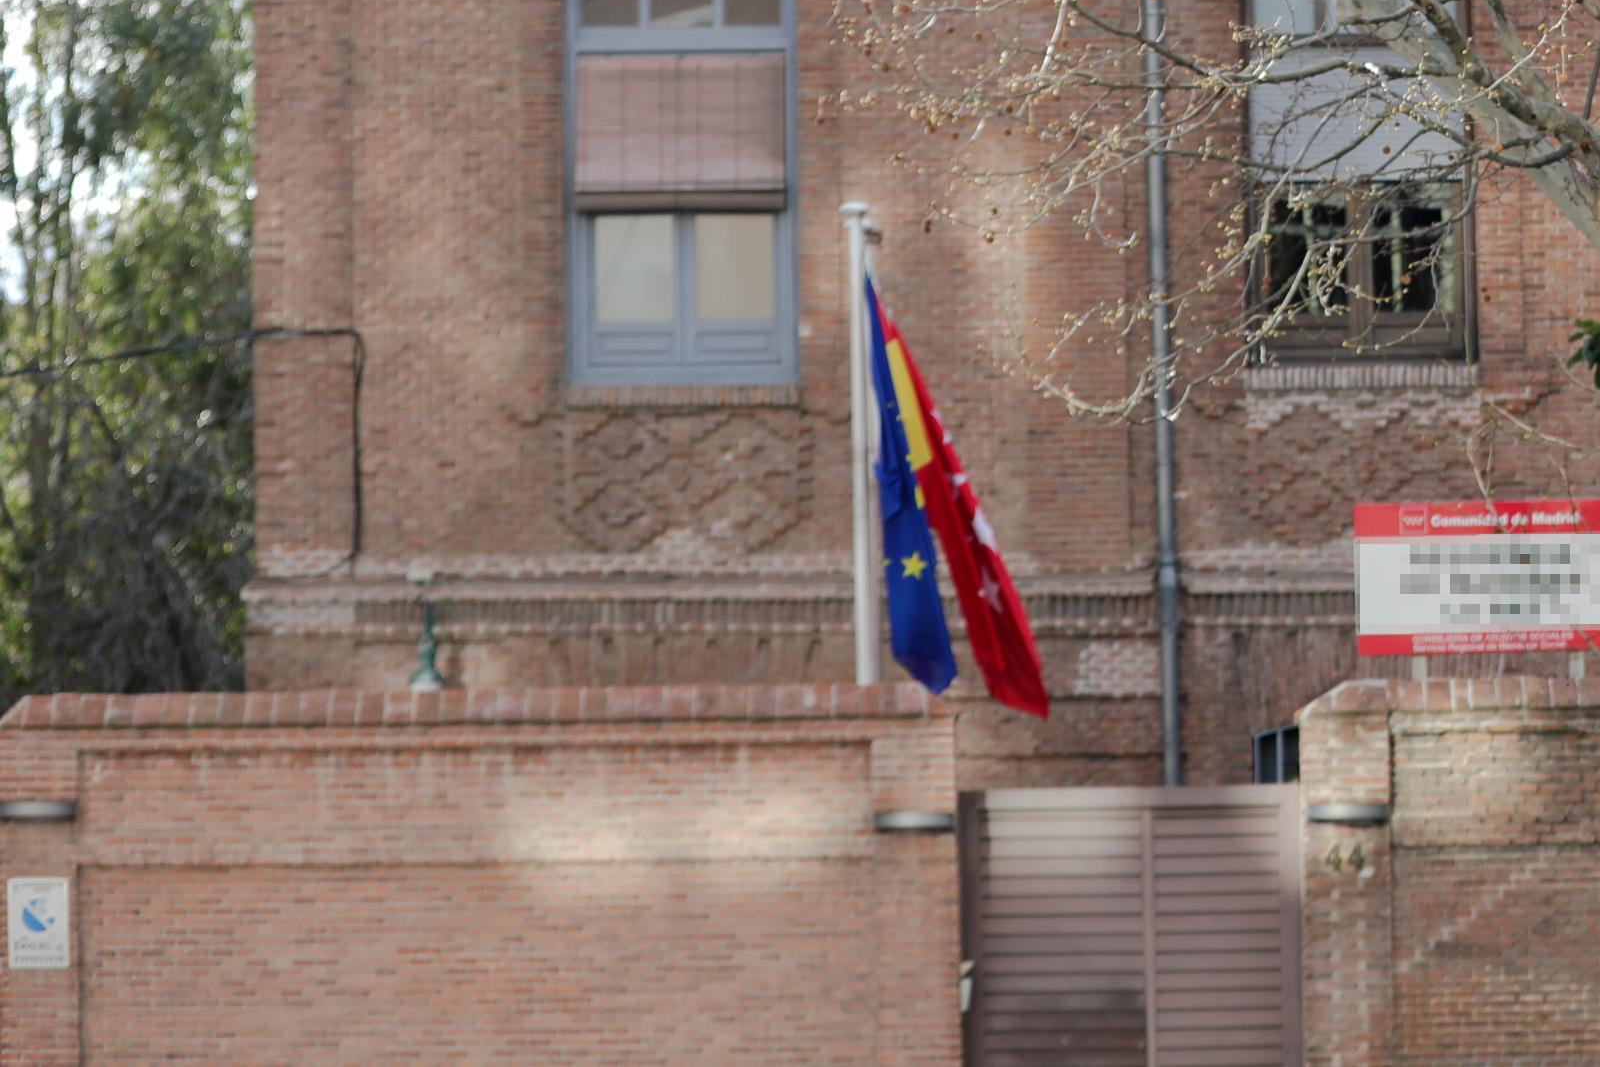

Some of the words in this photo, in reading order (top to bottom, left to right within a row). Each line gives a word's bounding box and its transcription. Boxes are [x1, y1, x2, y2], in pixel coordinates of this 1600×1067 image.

[1430, 513, 1508, 527] Comunidad
[1511, 512, 1529, 526] de
[1531, 510, 1580, 525] Madrid
[1326, 842, 1364, 871] 44
